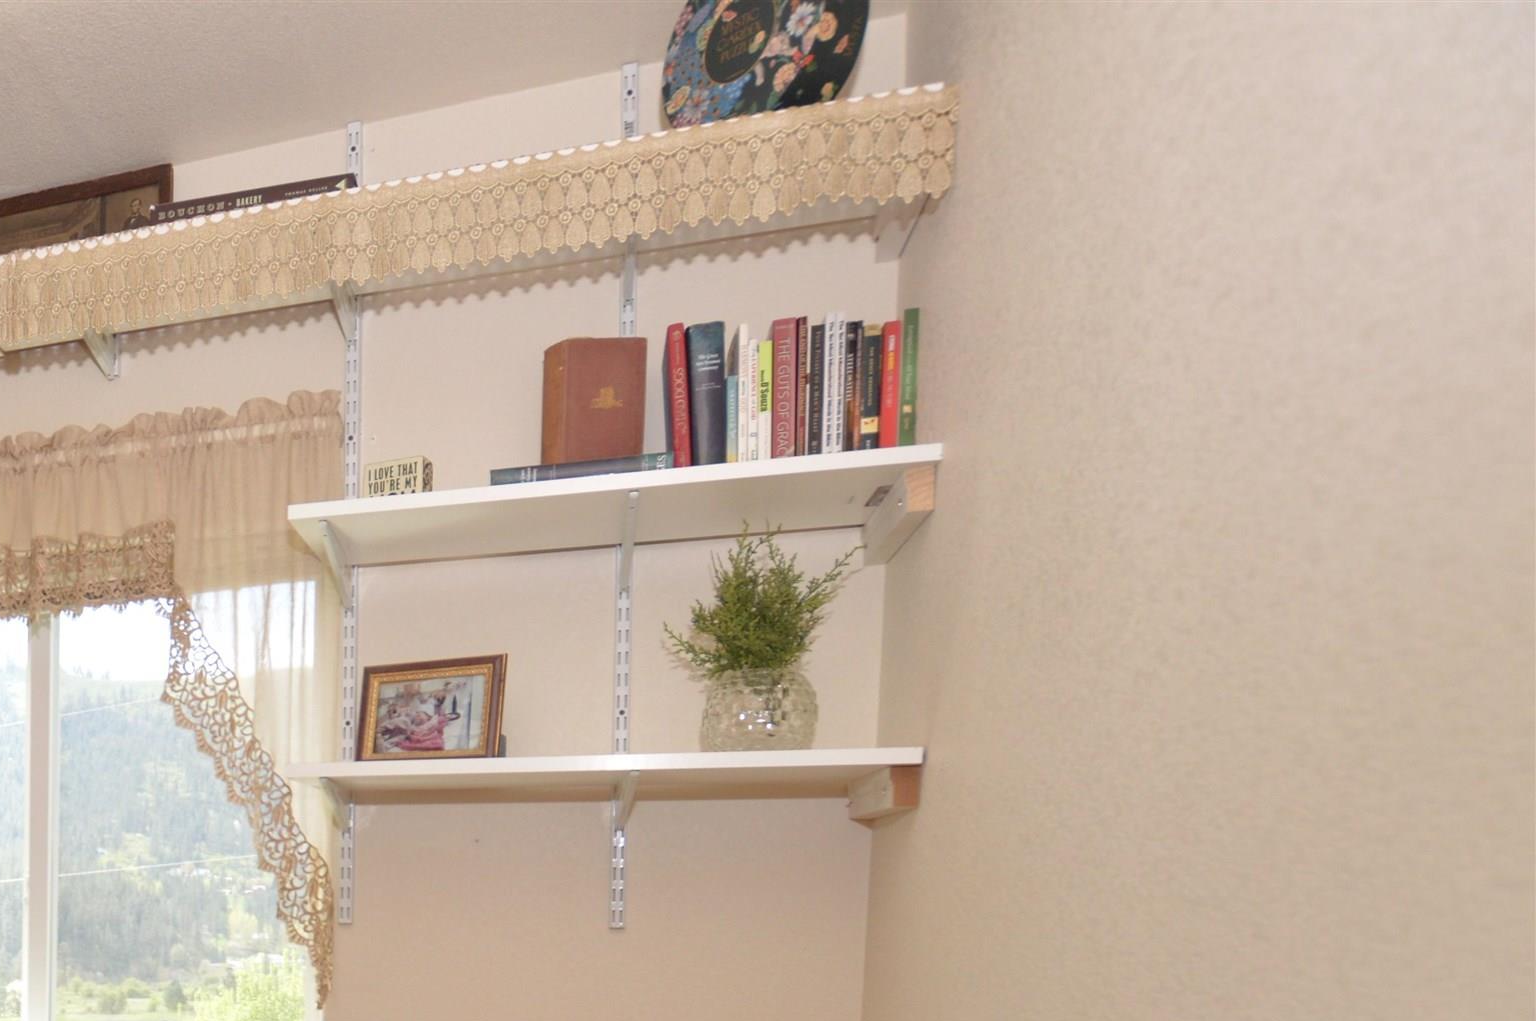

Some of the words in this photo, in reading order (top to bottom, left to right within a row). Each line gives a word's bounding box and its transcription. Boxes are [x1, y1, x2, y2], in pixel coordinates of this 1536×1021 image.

[158, 202, 225, 221] BOUCHON
[235, 195, 263, 208] BAKERY
[777, 337, 792, 361] THE
[777, 365, 791, 399] GUTS
[760, 382, 770, 412] D'Souza
[776, 401, 790, 418] OF
[775, 421, 790, 457] GRAC
[368, 469, 372, 481] I
[374, 465, 394, 480] LOVE
[398, 461, 418, 476] THAT
[368, 477, 400, 495] YOU'RE
[405, 475, 417, 489] MY
